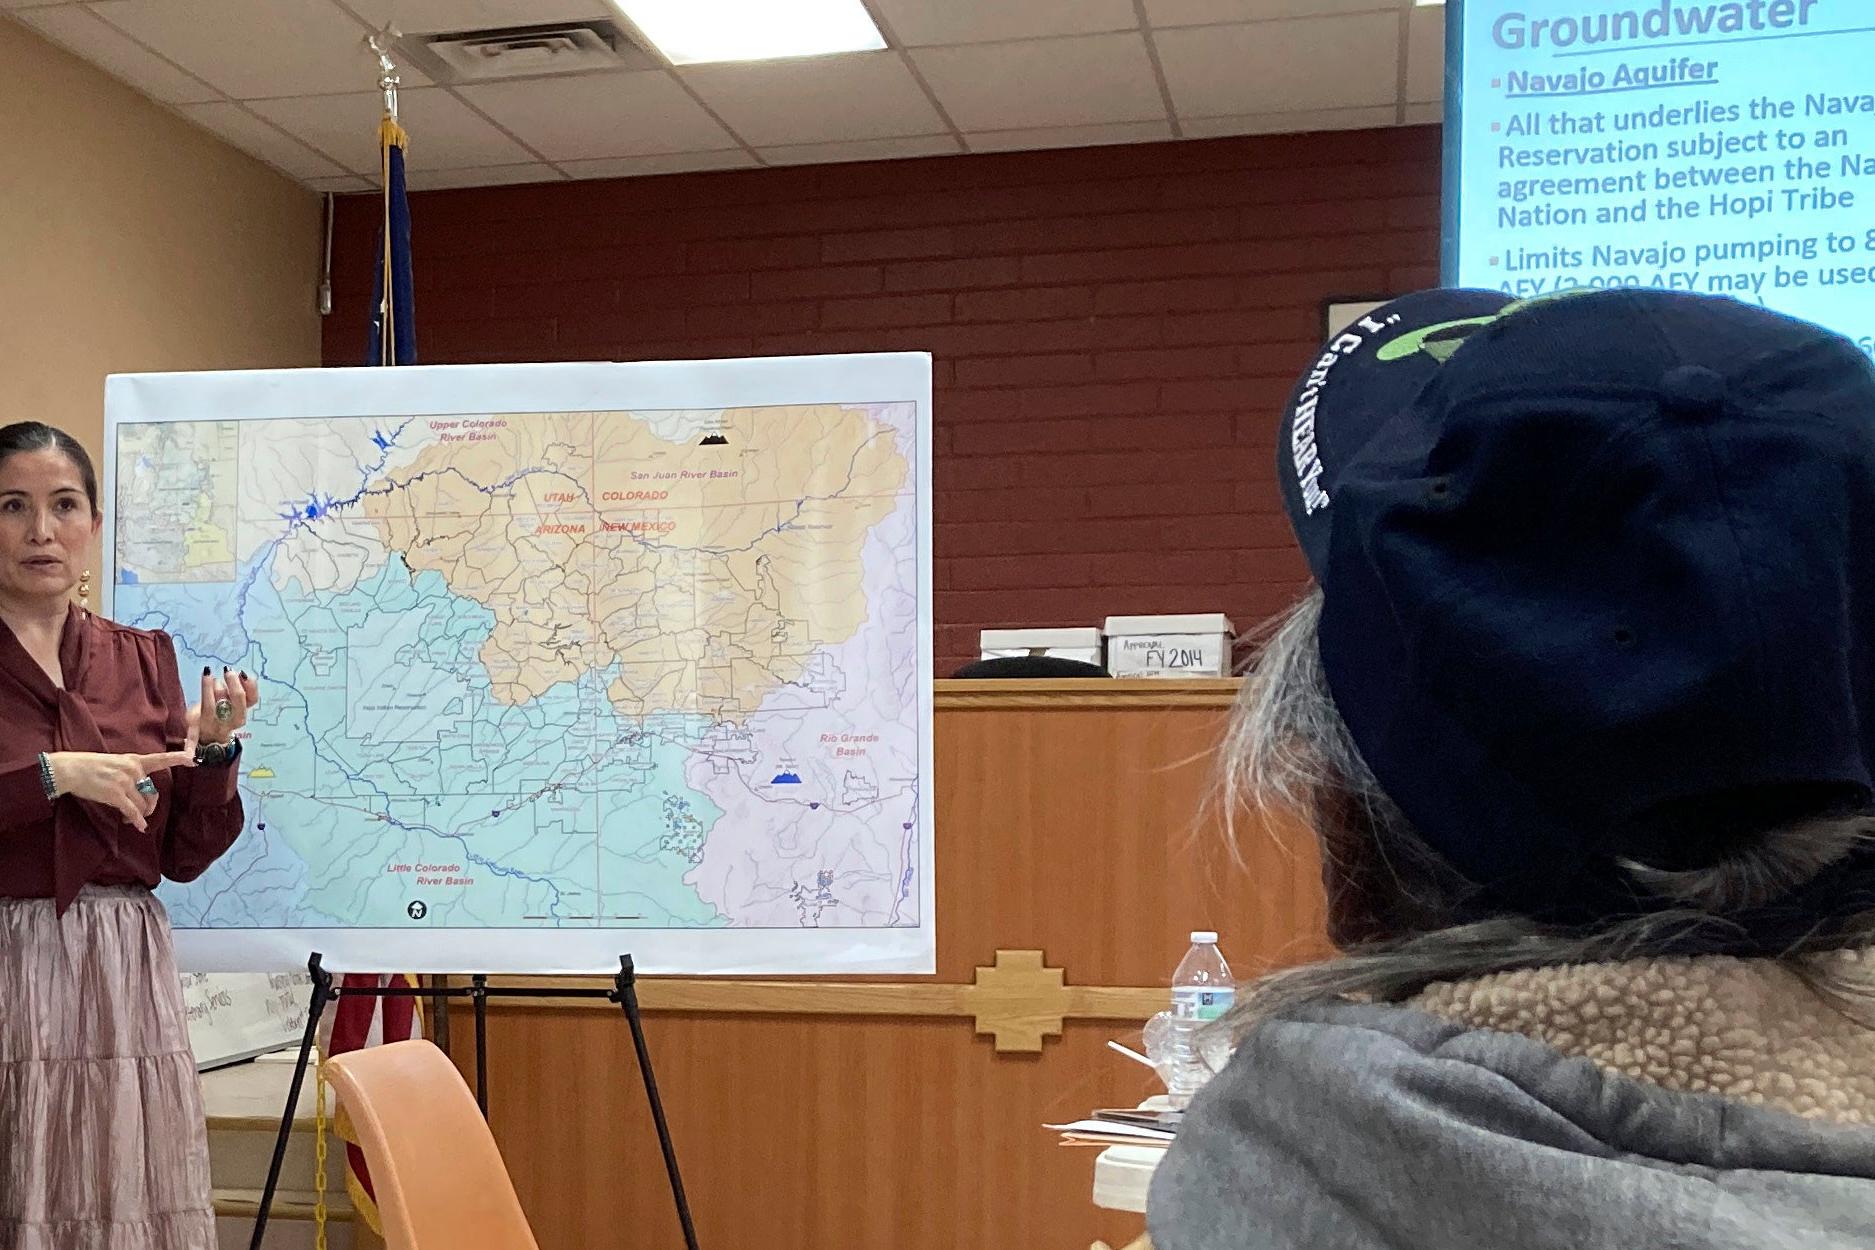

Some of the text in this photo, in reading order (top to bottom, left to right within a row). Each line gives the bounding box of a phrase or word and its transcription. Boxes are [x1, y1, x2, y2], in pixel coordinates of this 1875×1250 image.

[1492, 0, 1817, 49] Groundwater
[1507, 57, 1718, 94] Navajo Aquifer
[1506, 93, 1875, 137] All that underlies the Nava
[1498, 127, 1848, 168] Reservation subject to an
[1498, 171, 1645, 202] agreement
[1655, 161, 1774, 191] between
[1784, 155, 1831, 181] the
[1498, 186, 1854, 228] Nation and the Hopi Tribe
[1506, 245, 1582, 271] Limits
[1592, 240, 1685, 268] Navajo
[1695, 232, 1817, 267] pumping
[1826, 231, 1855, 253] to
[1708, 270, 1767, 294] may
[1774, 265, 1808, 288] be
[430, 419, 508, 431] Upper Colorado
[440, 432, 497, 442] River Basin
[630, 469, 739, 480] San Juan River Basin
[544, 491, 669, 503] UTAH COLORADO
[535, 521, 676, 535] ARIZONA NEW MEXICO
[1146, 648, 1203, 668] FY 2014
[820, 733, 880, 742] Rio Grande
[836, 747, 866, 756] Basin
[387, 863, 411, 873] Little
[414, 863, 461, 873] Colorado
[417, 876, 474, 886] River Basin
